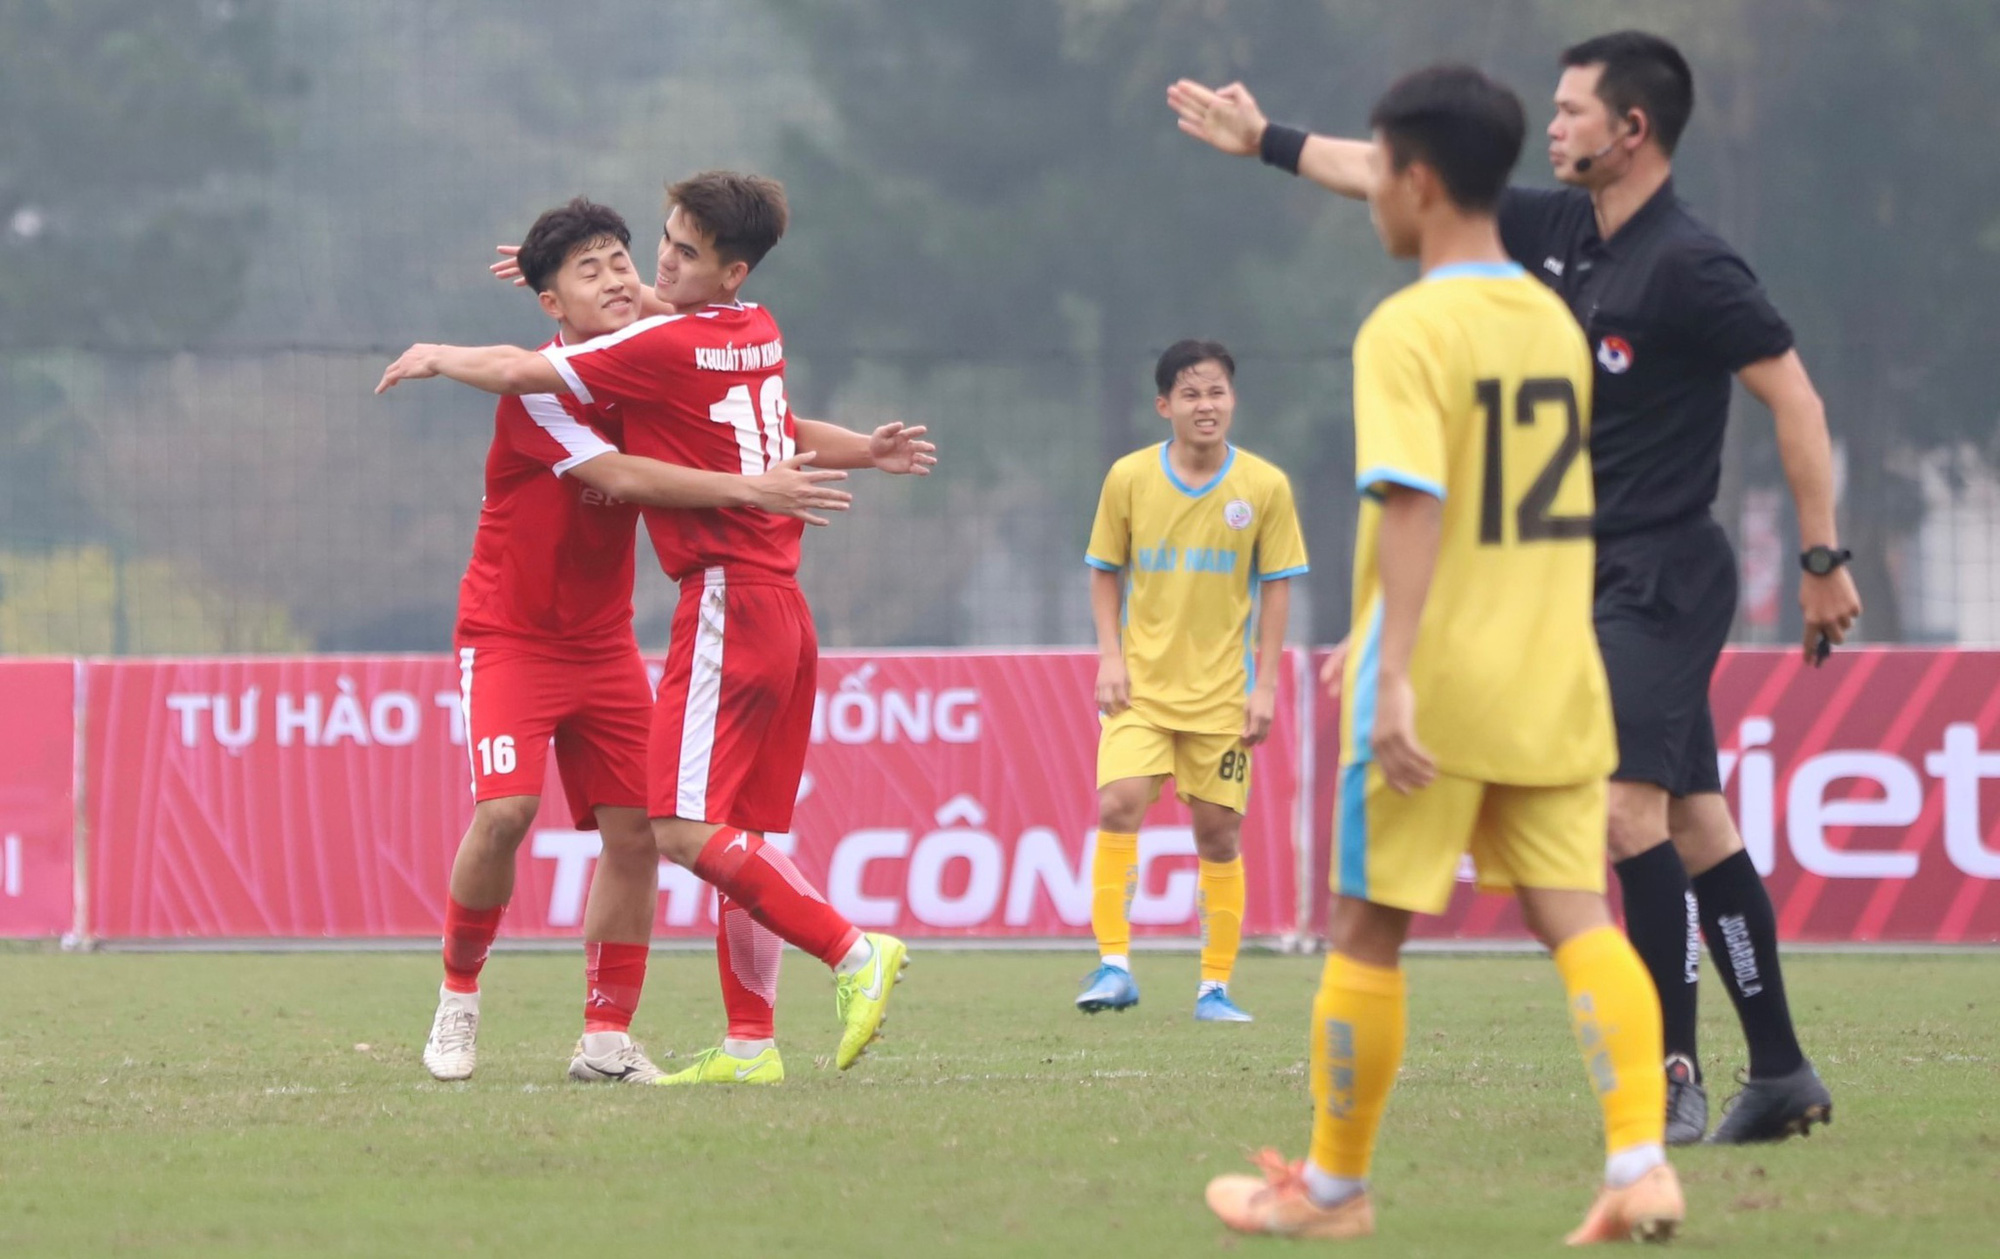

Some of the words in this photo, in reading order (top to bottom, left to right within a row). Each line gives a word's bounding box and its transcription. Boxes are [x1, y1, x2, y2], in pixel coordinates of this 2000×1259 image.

[708, 374, 796, 477] 10
[1474, 377, 1595, 546] 12
[1184, 547, 1237, 574] NAM
[166, 686, 261, 757] TỰ
[276, 674, 421, 747] HÀO
[476, 734, 517, 776] 16
[1218, 750, 1247, 784] 88
[1717, 716, 2000, 879] iet
[827, 792, 1198, 928] CÔNG
[1717, 912, 1764, 999] JOGARBOLA
